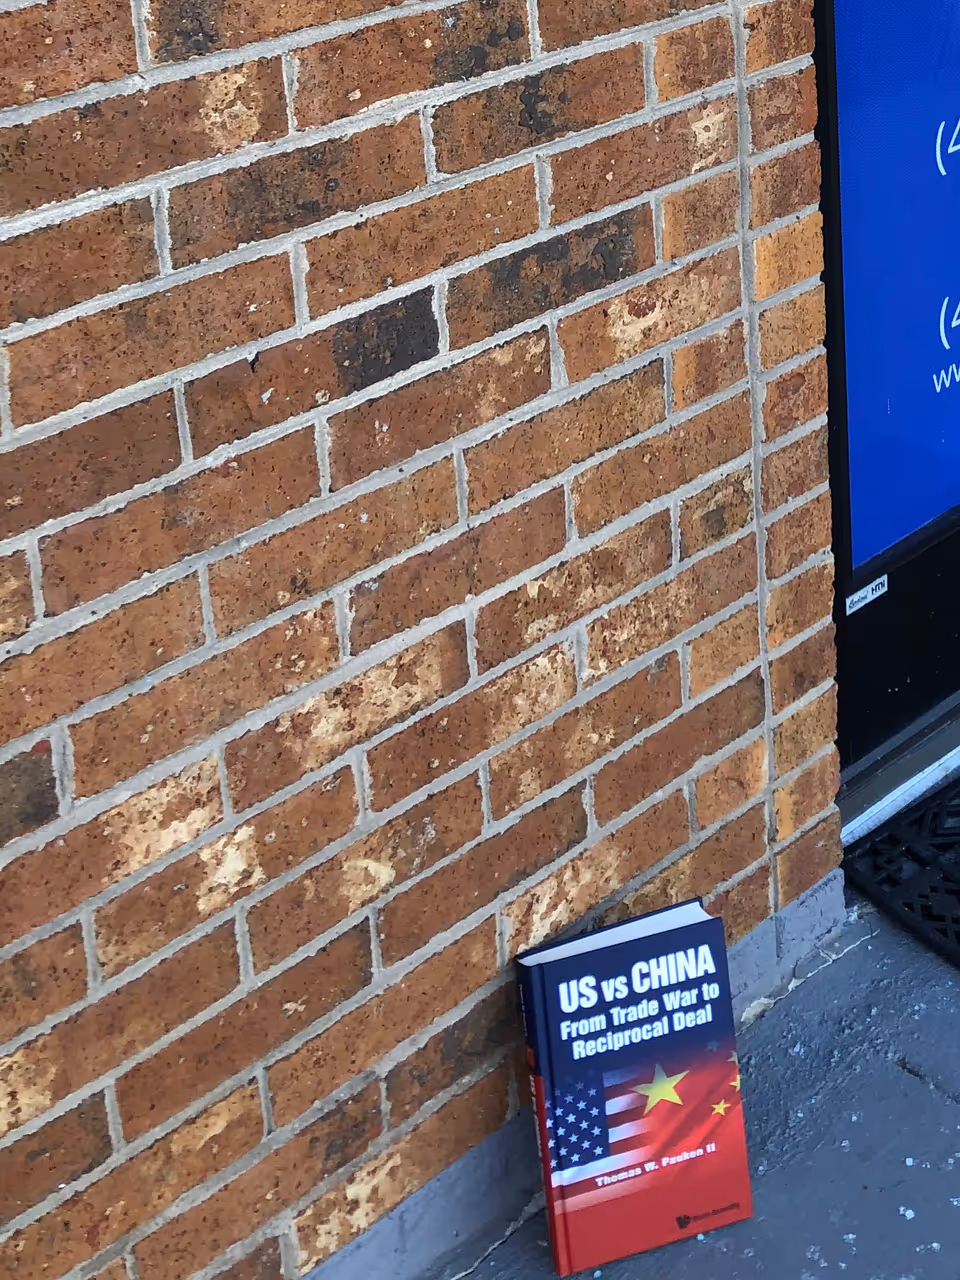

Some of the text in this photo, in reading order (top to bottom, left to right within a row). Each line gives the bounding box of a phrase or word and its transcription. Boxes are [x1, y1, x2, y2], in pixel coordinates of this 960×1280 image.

[558, 975, 598, 1013] US
[600, 975, 629, 1002] vs
[631, 944, 716, 993] CHINA
[560, 982, 720, 1041] From Trade War to
[572, 1003, 713, 1060] Reciprocal Deal
[594, 1167, 642, 1187] Thomas
[661, 1148, 704, 1167] Pauken
